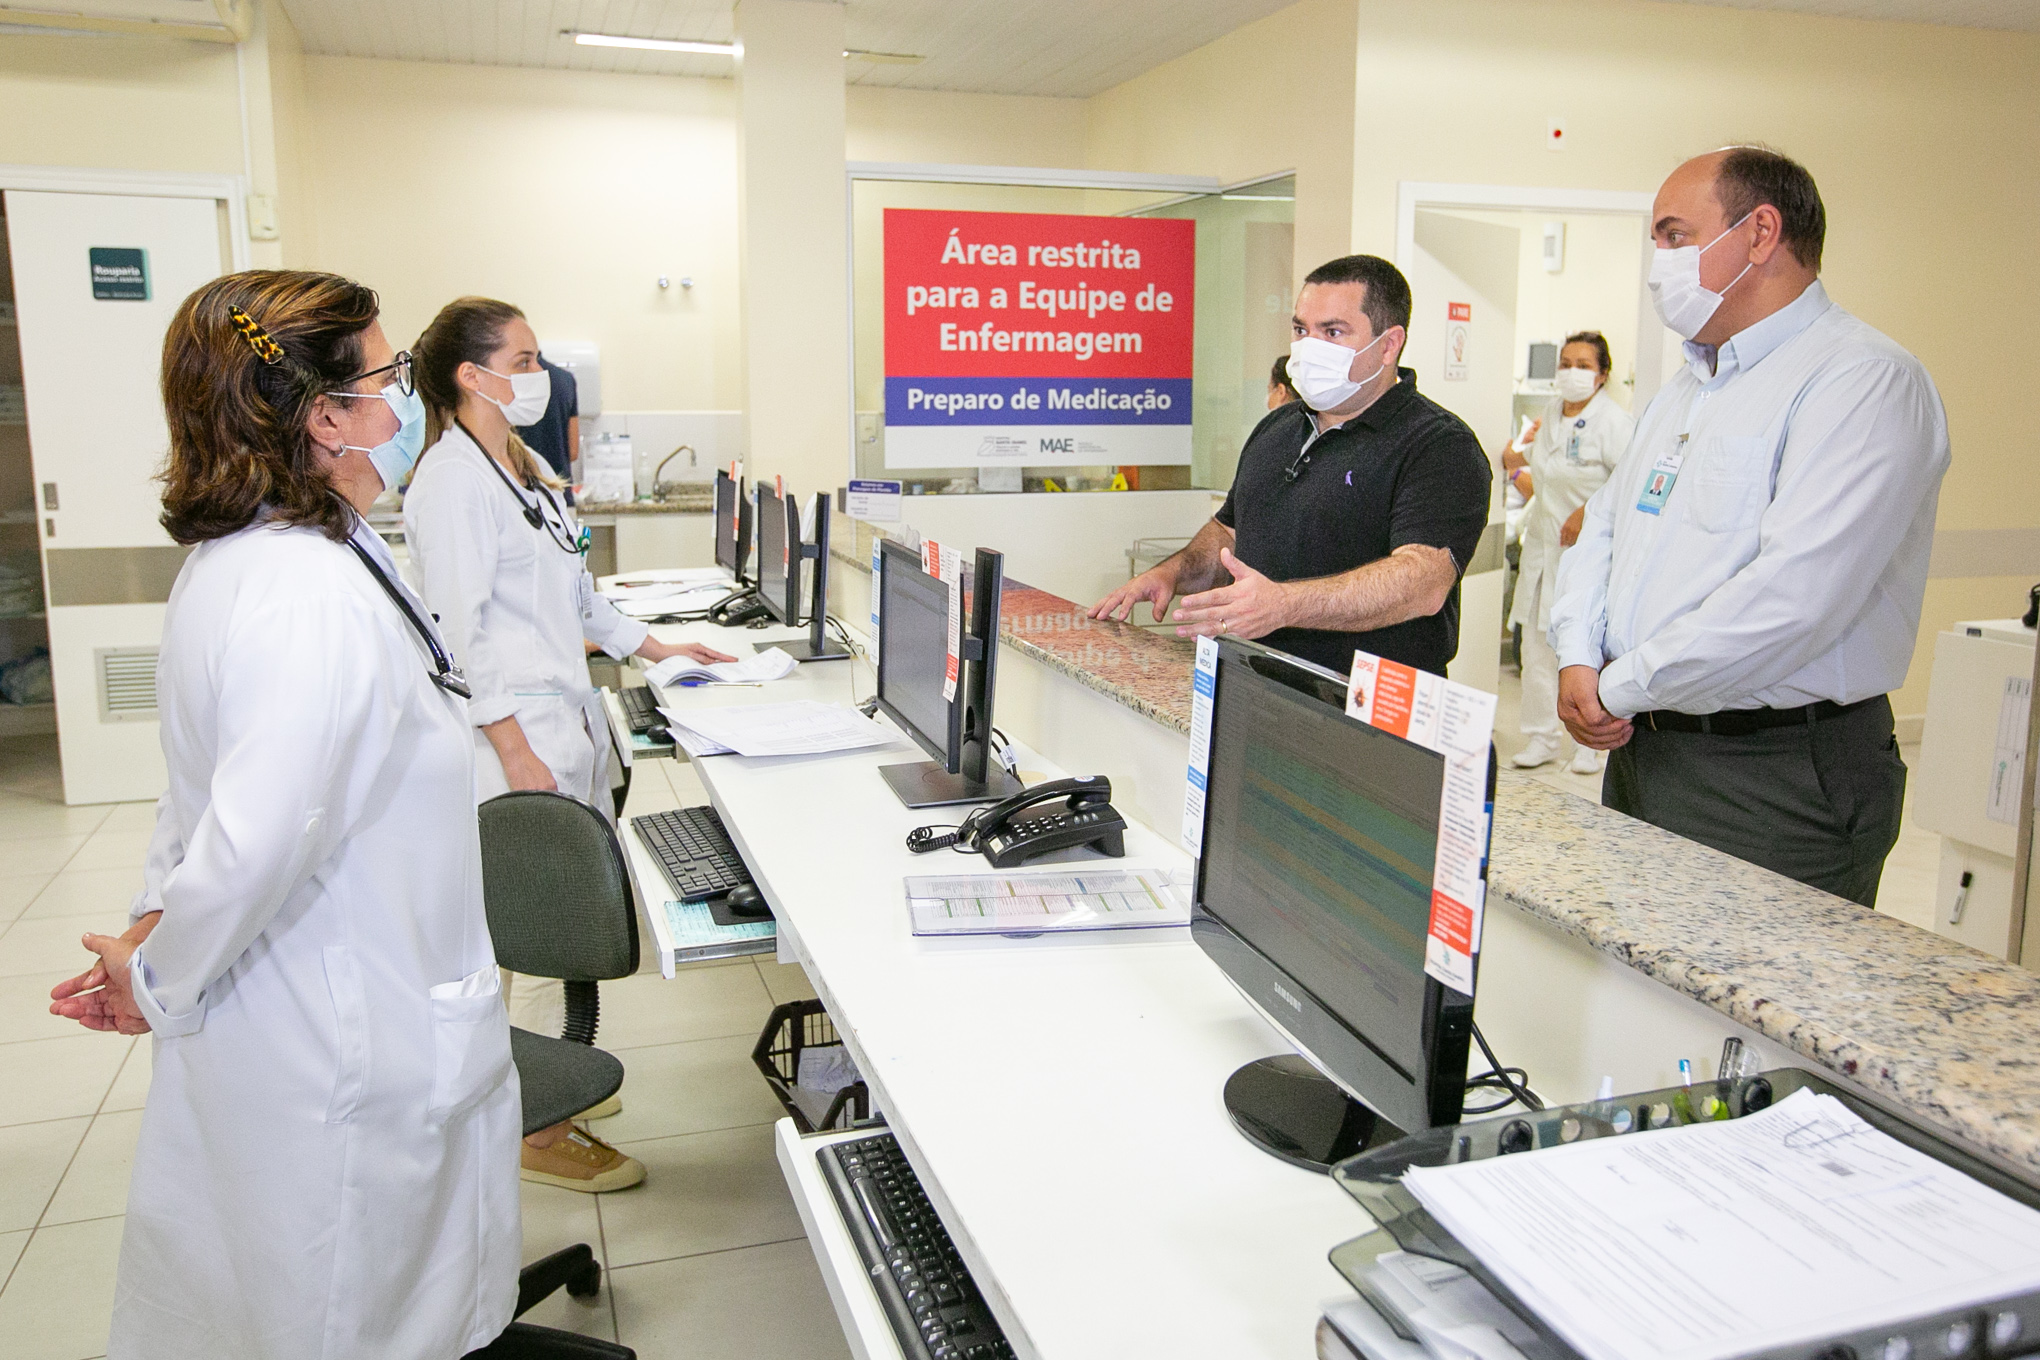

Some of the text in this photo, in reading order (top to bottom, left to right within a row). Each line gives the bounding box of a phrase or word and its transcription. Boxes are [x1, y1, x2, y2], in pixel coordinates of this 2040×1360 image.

[941, 227, 1141, 269] Área restrita
[907, 281, 1173, 318] para a Equipe de
[940, 322, 1142, 360] Enfermagem
[907, 387, 1171, 416] Preparo de Medicação
[1040, 438, 1074, 453] MAE
[1356, 658, 1375, 673] SEPSE
[1274, 981, 1301, 1012] SAMSUNG
